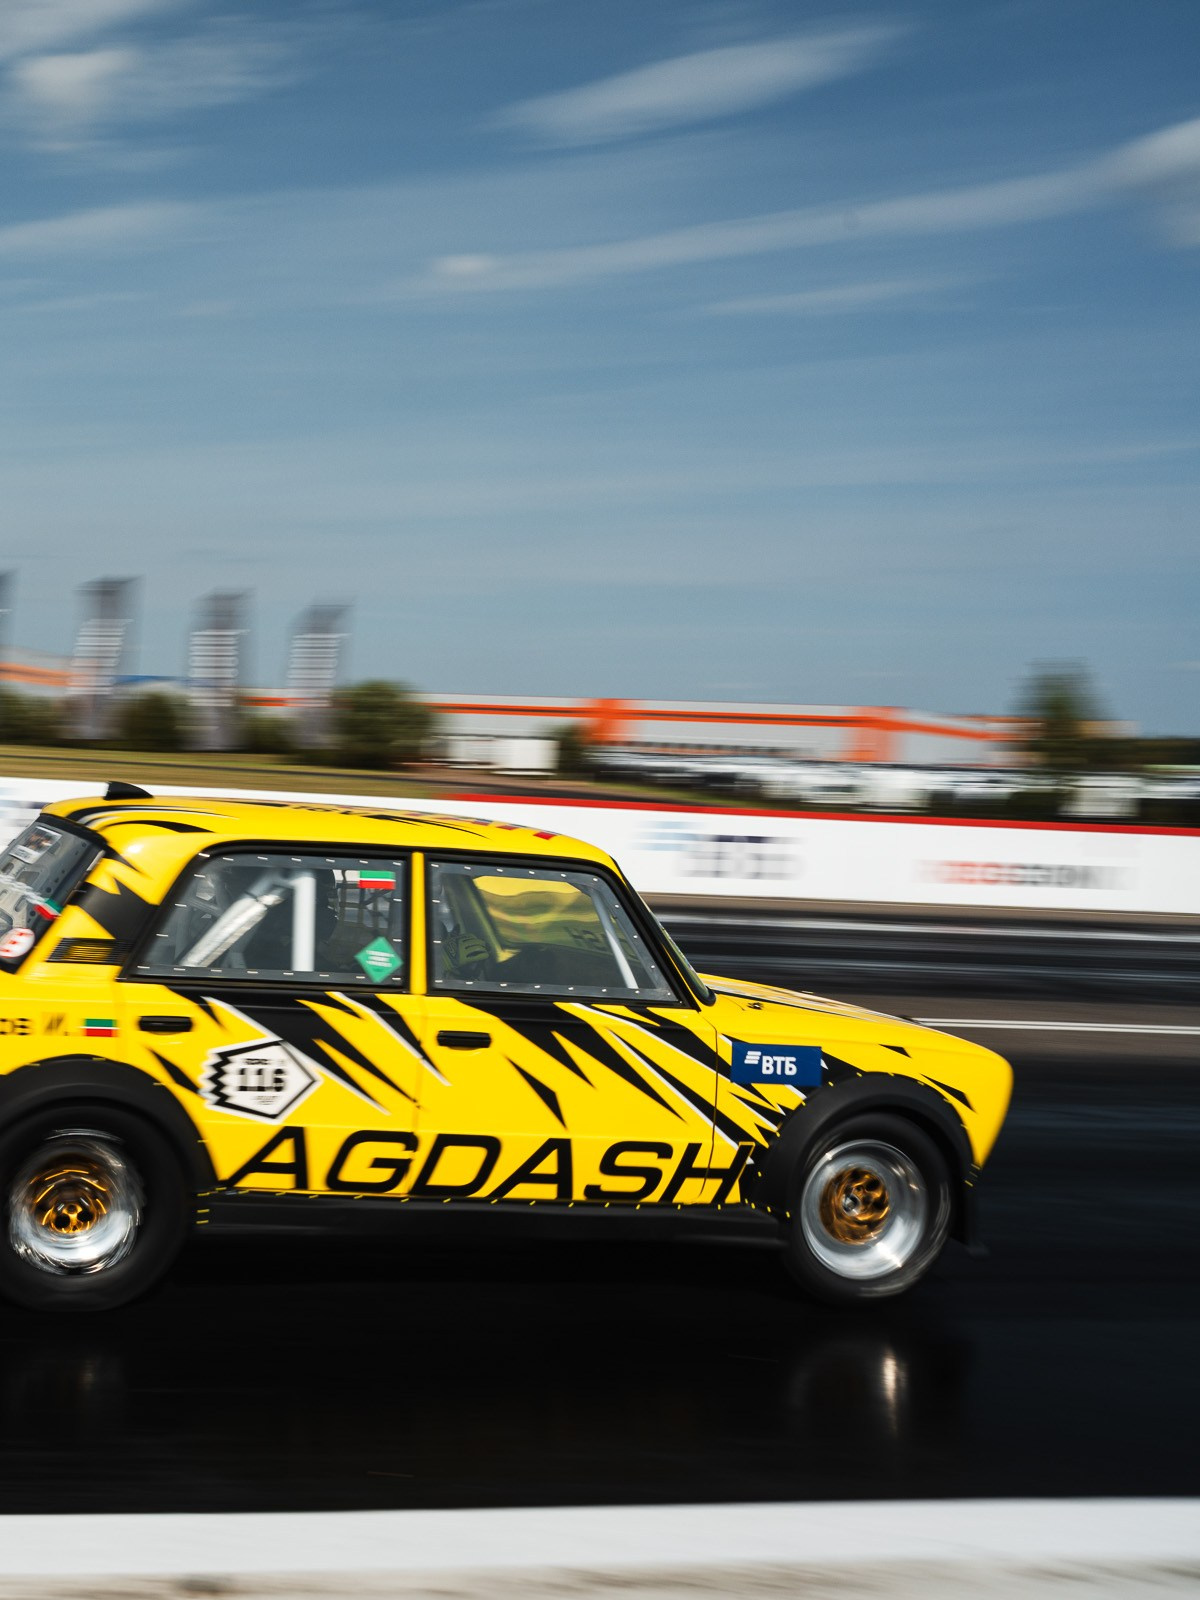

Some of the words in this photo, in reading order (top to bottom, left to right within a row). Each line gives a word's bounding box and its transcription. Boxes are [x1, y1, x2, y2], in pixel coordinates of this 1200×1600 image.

[761, 1055, 798, 1076] ВТБ
[237, 1067, 286, 1092] 116
[225, 1126, 752, 1204] AGDASH
